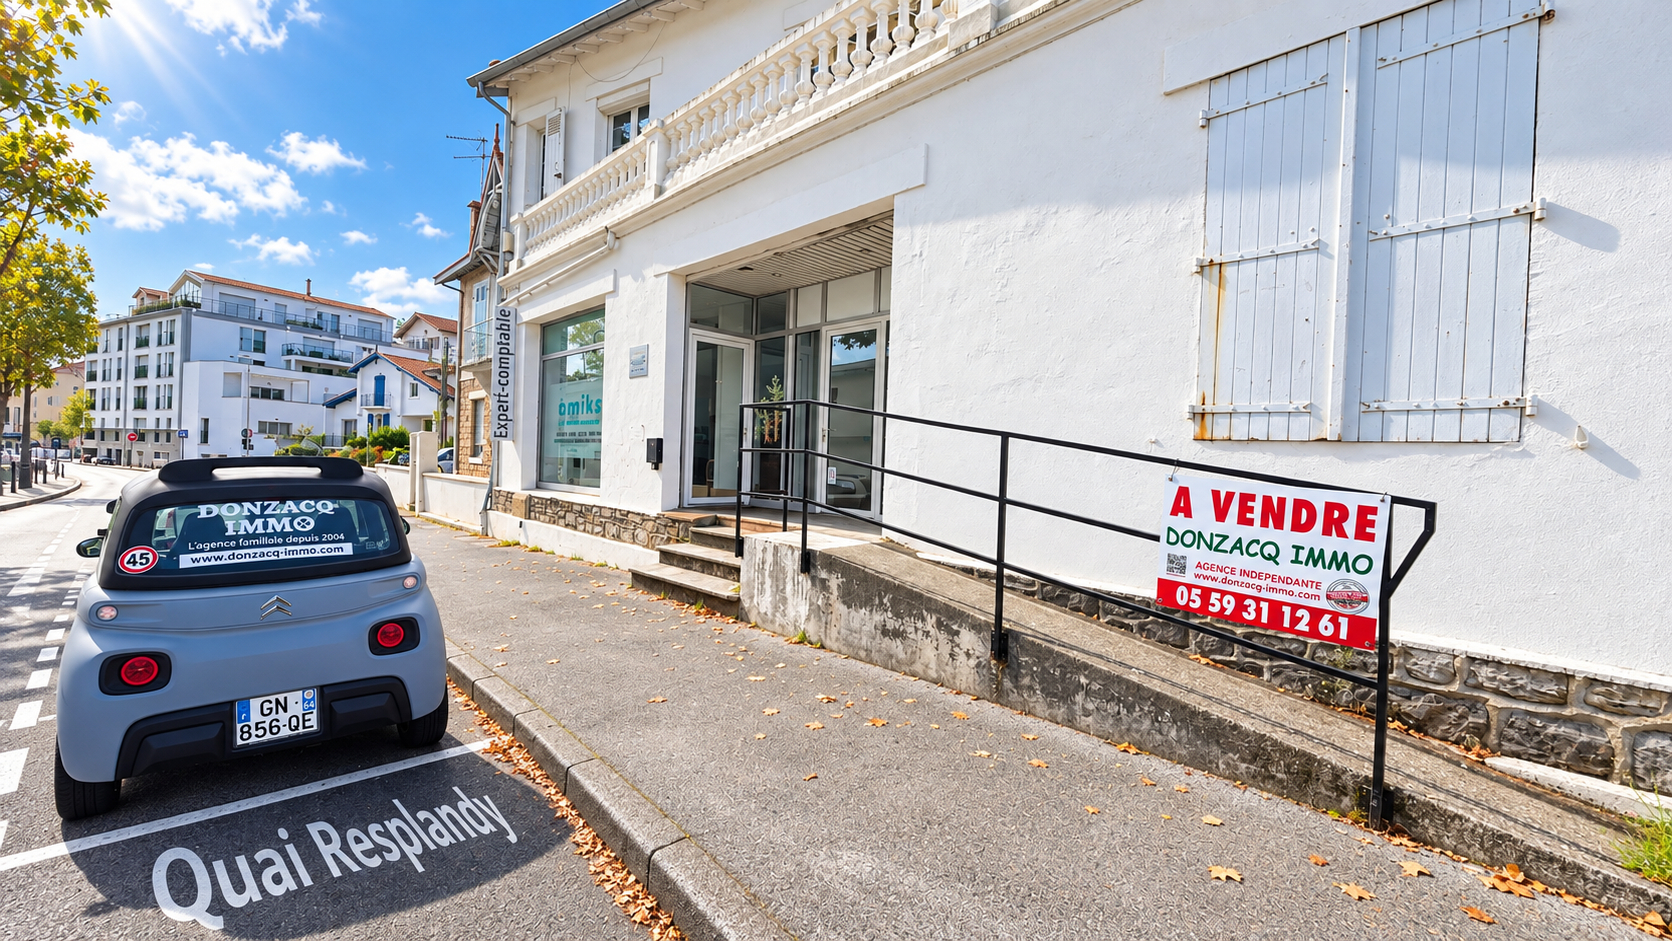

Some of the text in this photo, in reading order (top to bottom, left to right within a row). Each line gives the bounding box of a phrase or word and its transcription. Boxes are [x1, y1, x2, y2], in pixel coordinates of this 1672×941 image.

[197, 500, 335, 519] DONZACQ
[1169, 485, 1379, 543] A VENDRE
[225, 516, 315, 536] IMMO
[188, 540, 237, 551] L'agence
[285, 533, 320, 544] depuis
[322, 532, 345, 542] 2004
[1166, 526, 1374, 575] DONZACQ IMMO
[126, 552, 151, 567] 45
[190, 545, 344, 564] www.donzacq-immo.com
[1195, 561, 1323, 591] AGENCE INDEPENDANTE
[1176, 585, 1349, 641] 05 59 31 12 61
[303, 700, 315, 710] 64
[239, 711, 314, 742] 856-QE
